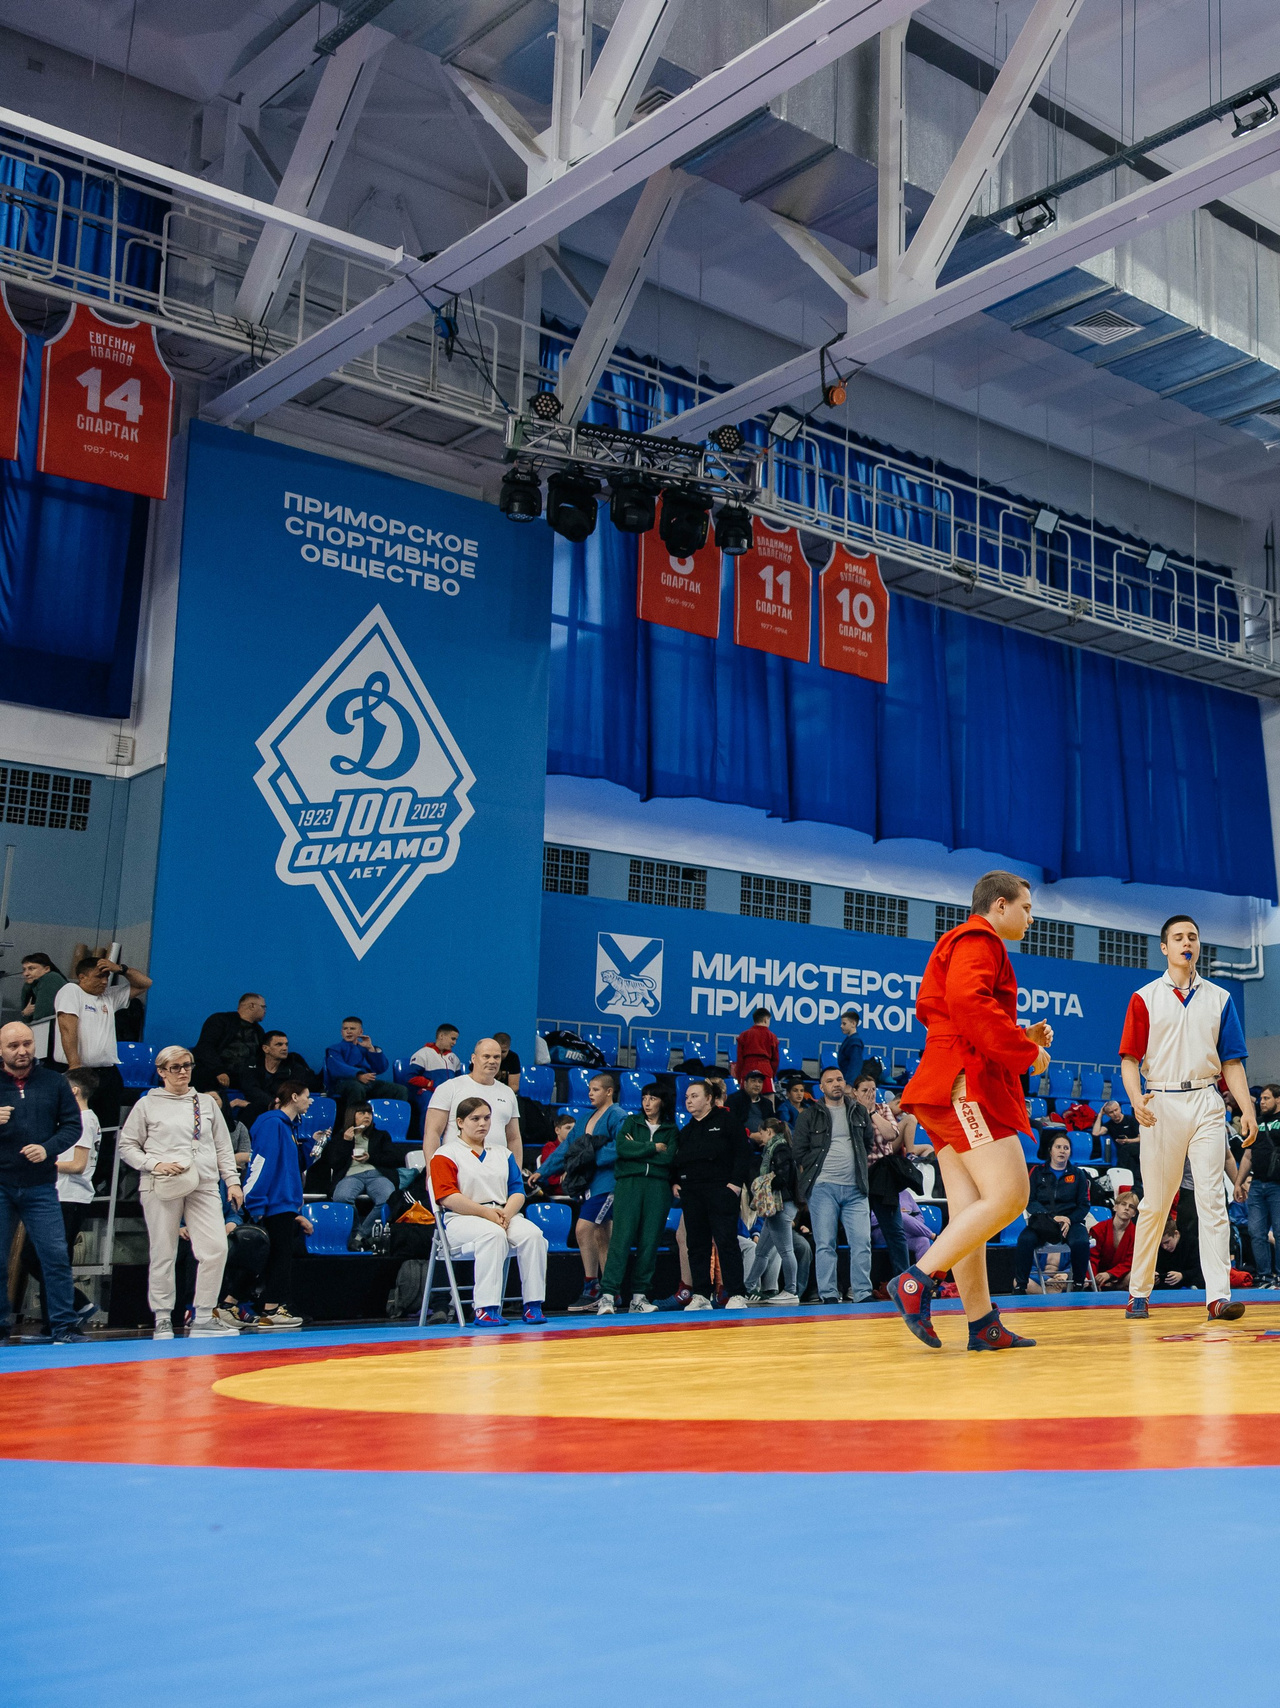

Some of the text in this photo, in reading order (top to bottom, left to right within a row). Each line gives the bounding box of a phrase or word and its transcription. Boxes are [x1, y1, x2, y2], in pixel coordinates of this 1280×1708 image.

[90, 345, 133, 367] ИВАНОВ
[76, 366, 144, 423] 14
[76, 414, 139, 443] СПАРТАК
[284, 491, 478, 558] ПРИМОРСКОЕ
[285, 516, 476, 579] СПОРТИВНОЕ
[300, 543, 460, 597] ОБЩЕСТВО
[661, 572, 701, 595] СПАРТАК
[758, 565, 791, 605] 11
[755, 599, 793, 621] СПАРТАК
[836, 587, 875, 628] 10
[838, 623, 873, 644] СПАРТАК
[298, 791, 447, 838] 1923 100 2023
[294, 836, 444, 867] ДИНАМО
[348, 865, 387, 880] ЛЕТ
